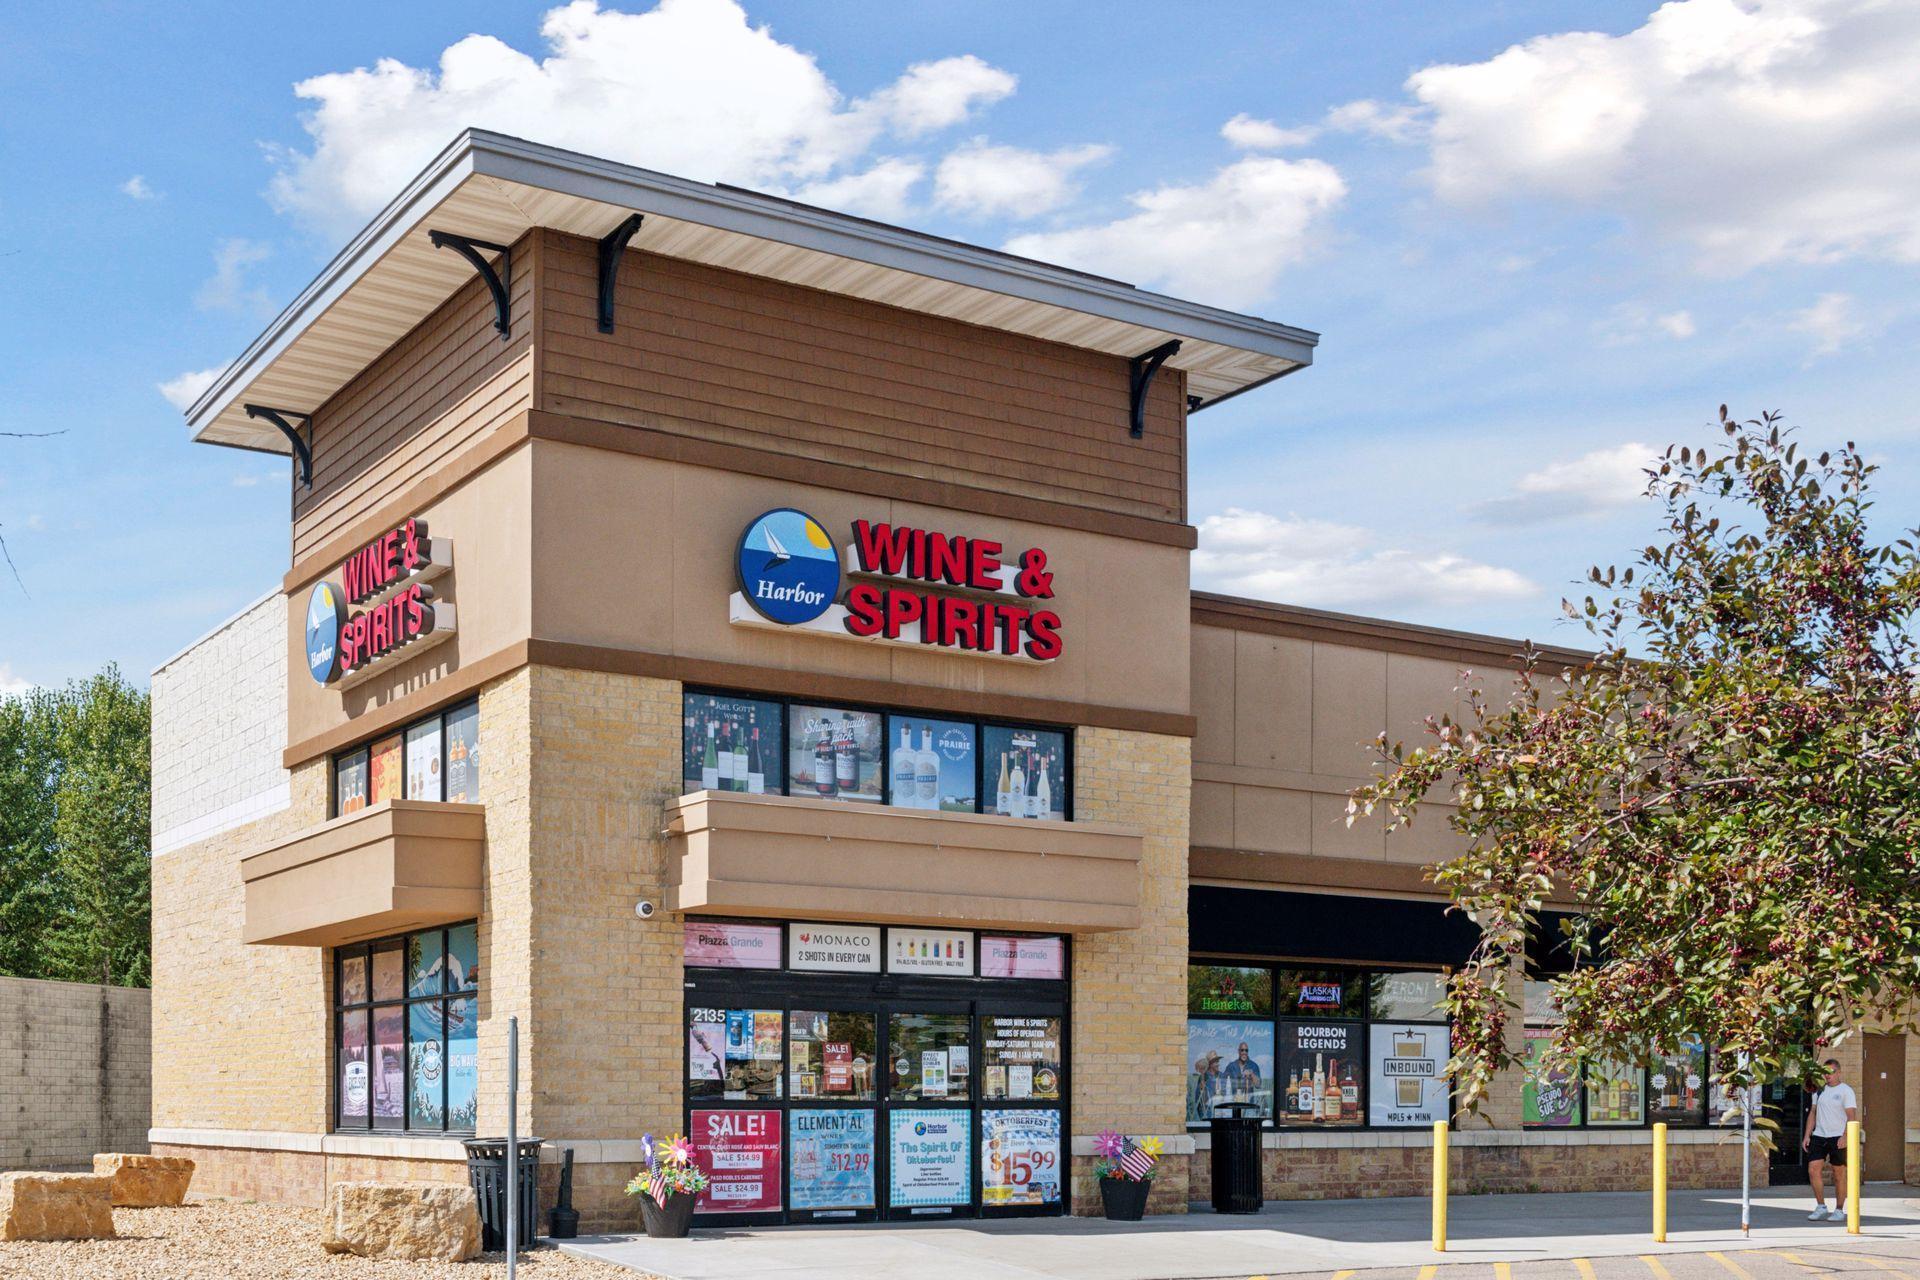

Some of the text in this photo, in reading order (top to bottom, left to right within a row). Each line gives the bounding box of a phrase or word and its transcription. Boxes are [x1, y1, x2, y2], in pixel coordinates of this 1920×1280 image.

[343, 517, 421, 603] WINE &
[852, 519, 1055, 599] WINE &
[757, 579, 826, 606] Harbor
[341, 583, 423, 671] SPIRITS
[844, 584, 1063, 660] SPIRITS
[311, 643, 333, 669] Harbor
[805, 715, 867, 735] Sharing with
[939, 739, 971, 750] PRAIRIE
[699, 934, 763, 948] Piazza Grande
[813, 934, 871, 947] MONACO
[799, 951, 871, 964] 2 SHOTS IN EVERY CAN
[992, 947, 1048, 960] Piazza Grande
[1298, 985, 1341, 1004] ALASKAN
[1384, 981, 1429, 995] PERONI
[1202, 997, 1253, 1011] Heineken
[694, 1009, 725, 1022] 2135
[1298, 1027, 1346, 1037] BOURBON
[826, 1044, 848, 1053] SALE!
[1298, 1038, 1346, 1049] LEGENDS
[1386, 1062, 1432, 1073] INBOUND
[1537, 1088, 1562, 1105] PSEUDO
[1539, 1101, 1555, 1117] SUE
[995, 1117, 1048, 1127] OKTOBERFEST
[1388, 1112, 1431, 1121] MPLS MINN
[708, 1114, 766, 1136] SALE!
[900, 1141, 962, 1155] The Spirit Of
[737, 1154, 760, 1162] $14.99
[831, 1153, 870, 1171] $12.99
[907, 1154, 956, 1165] Oktoberfest!
[735, 1184, 759, 1192] $24.99
